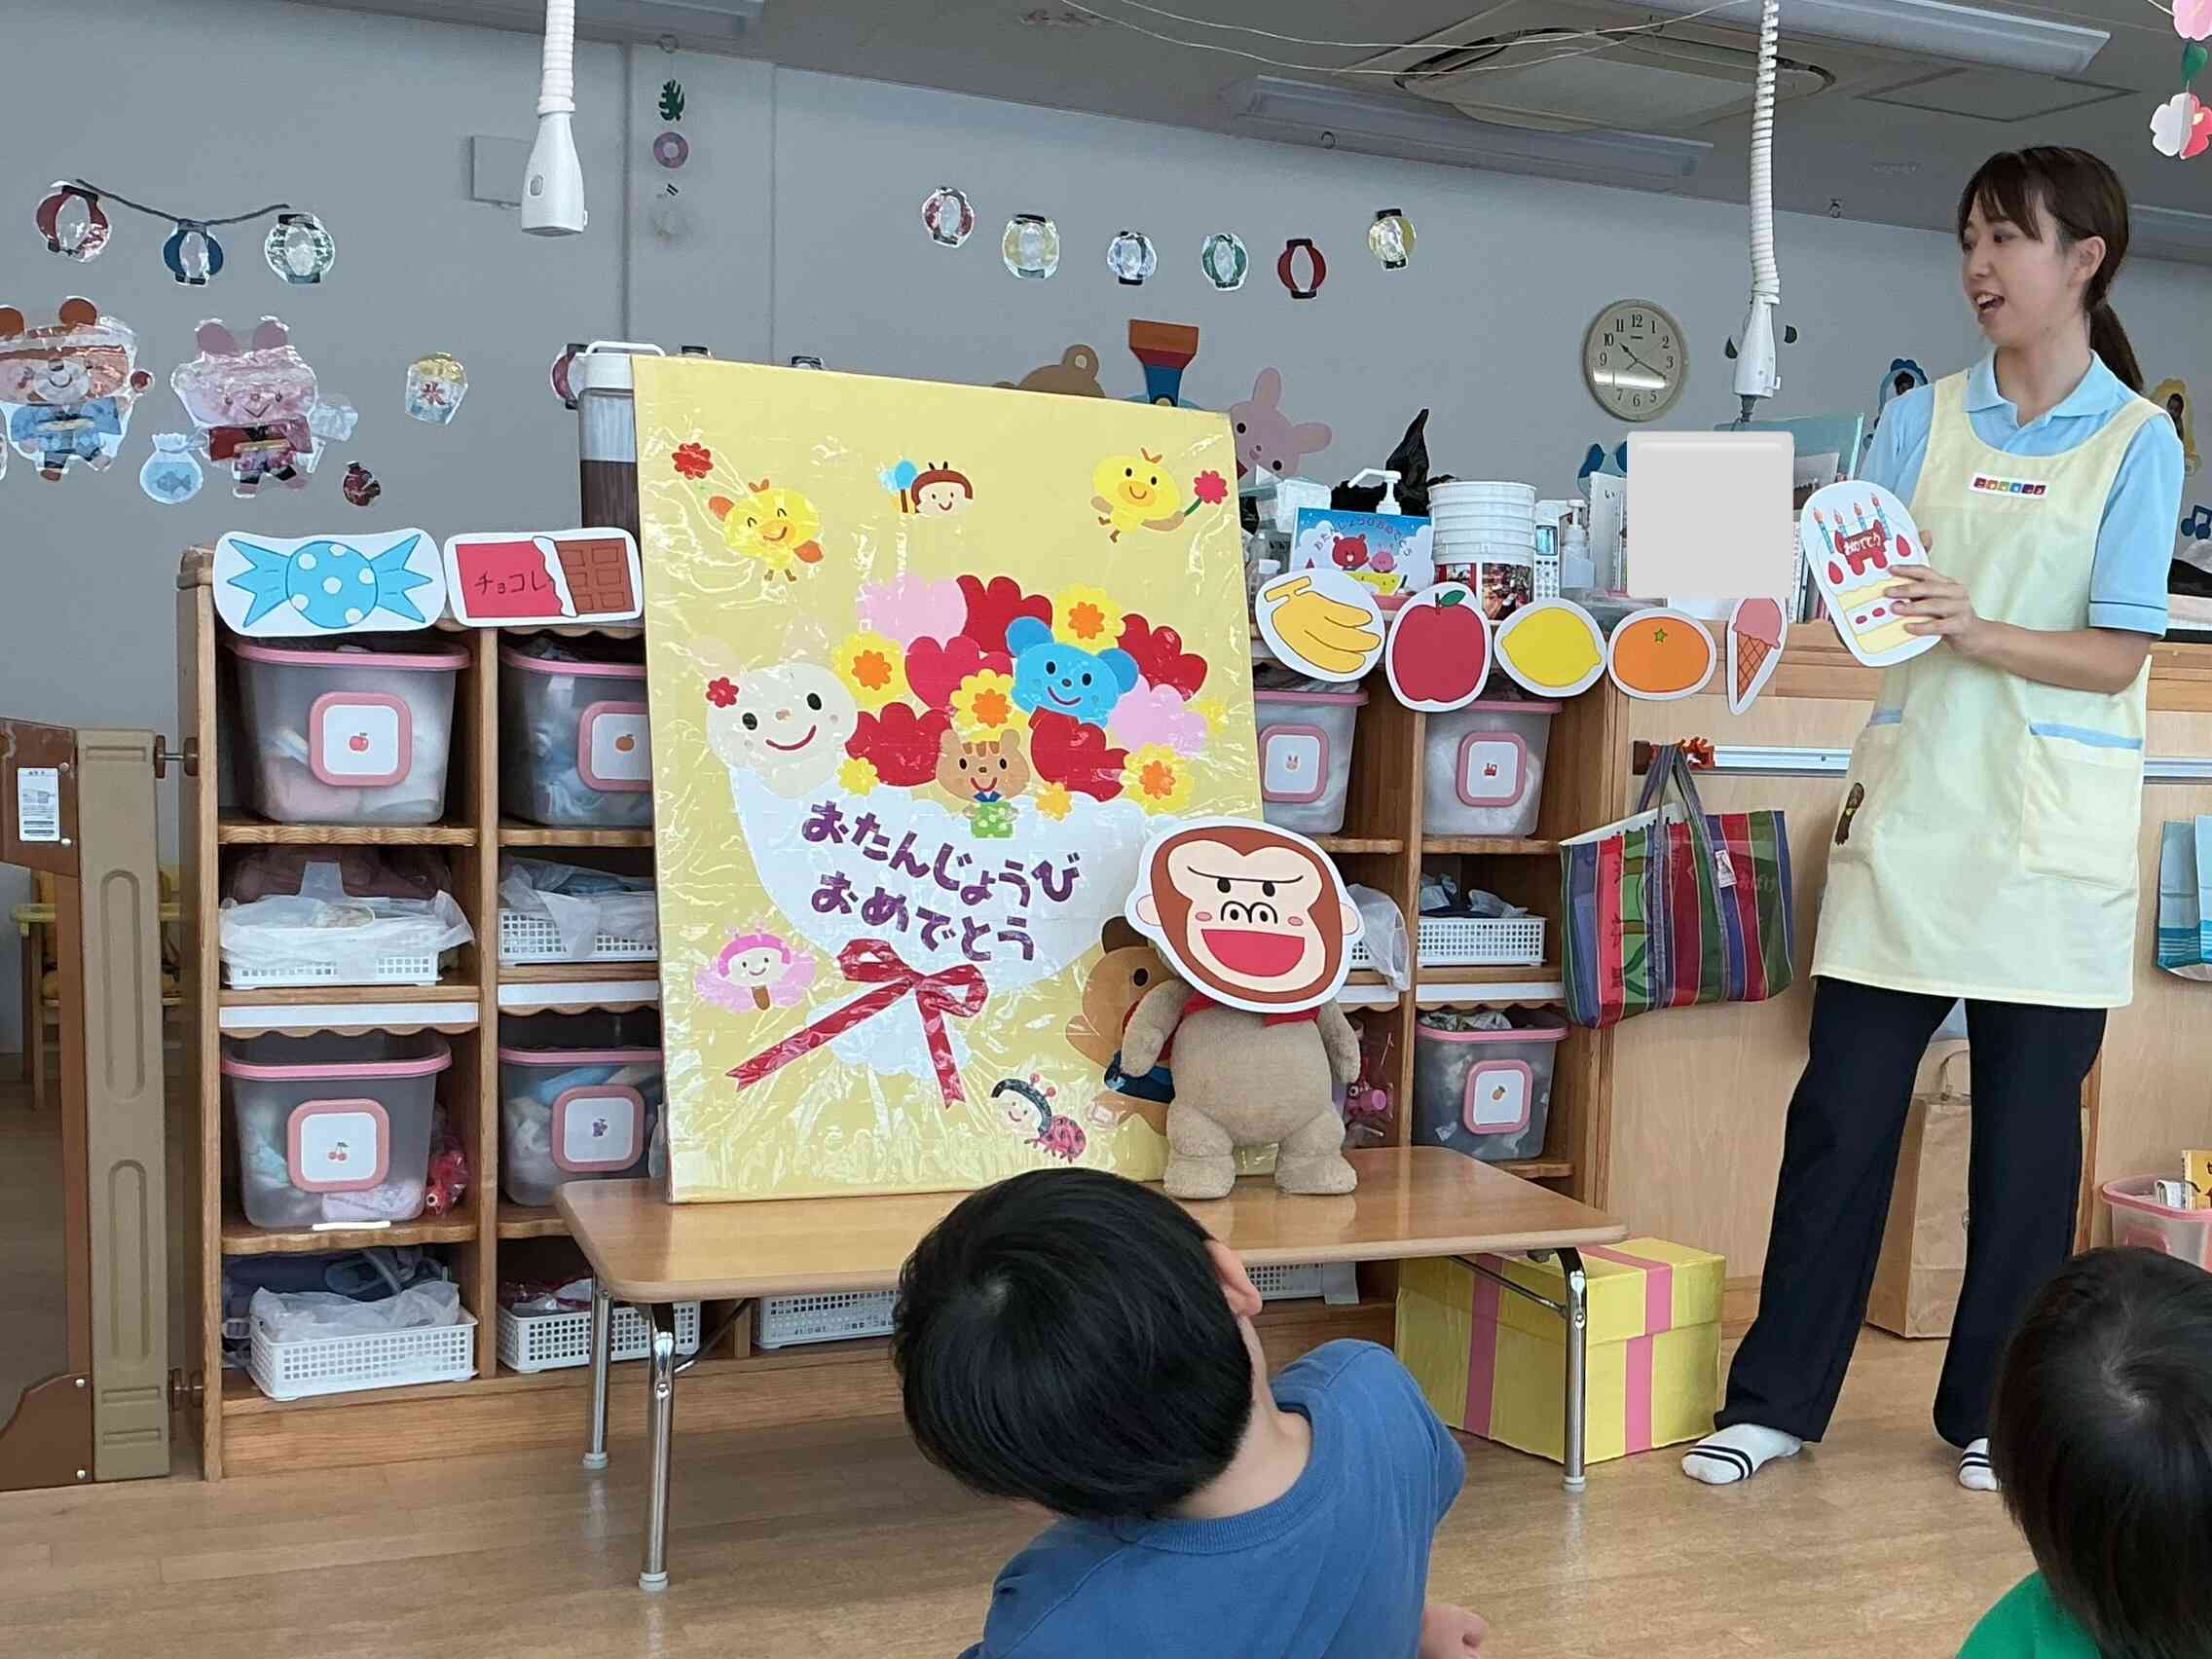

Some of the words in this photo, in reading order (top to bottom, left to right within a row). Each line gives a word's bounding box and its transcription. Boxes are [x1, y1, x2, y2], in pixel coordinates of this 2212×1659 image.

[1616, 318, 1624, 332] 11
[1631, 313, 1643, 328] 12
[1604, 333, 1614, 347] 10
[1662, 335, 1670, 349] 2
[1599, 351, 1608, 366] 9
[1666, 355, 1674, 369] 3
[1632, 394, 1641, 407] 6
[474, 570, 548, 595] チョコレ
[801, 800, 1081, 907] おたんじょうび
[811, 870, 1035, 962] おめでとう
